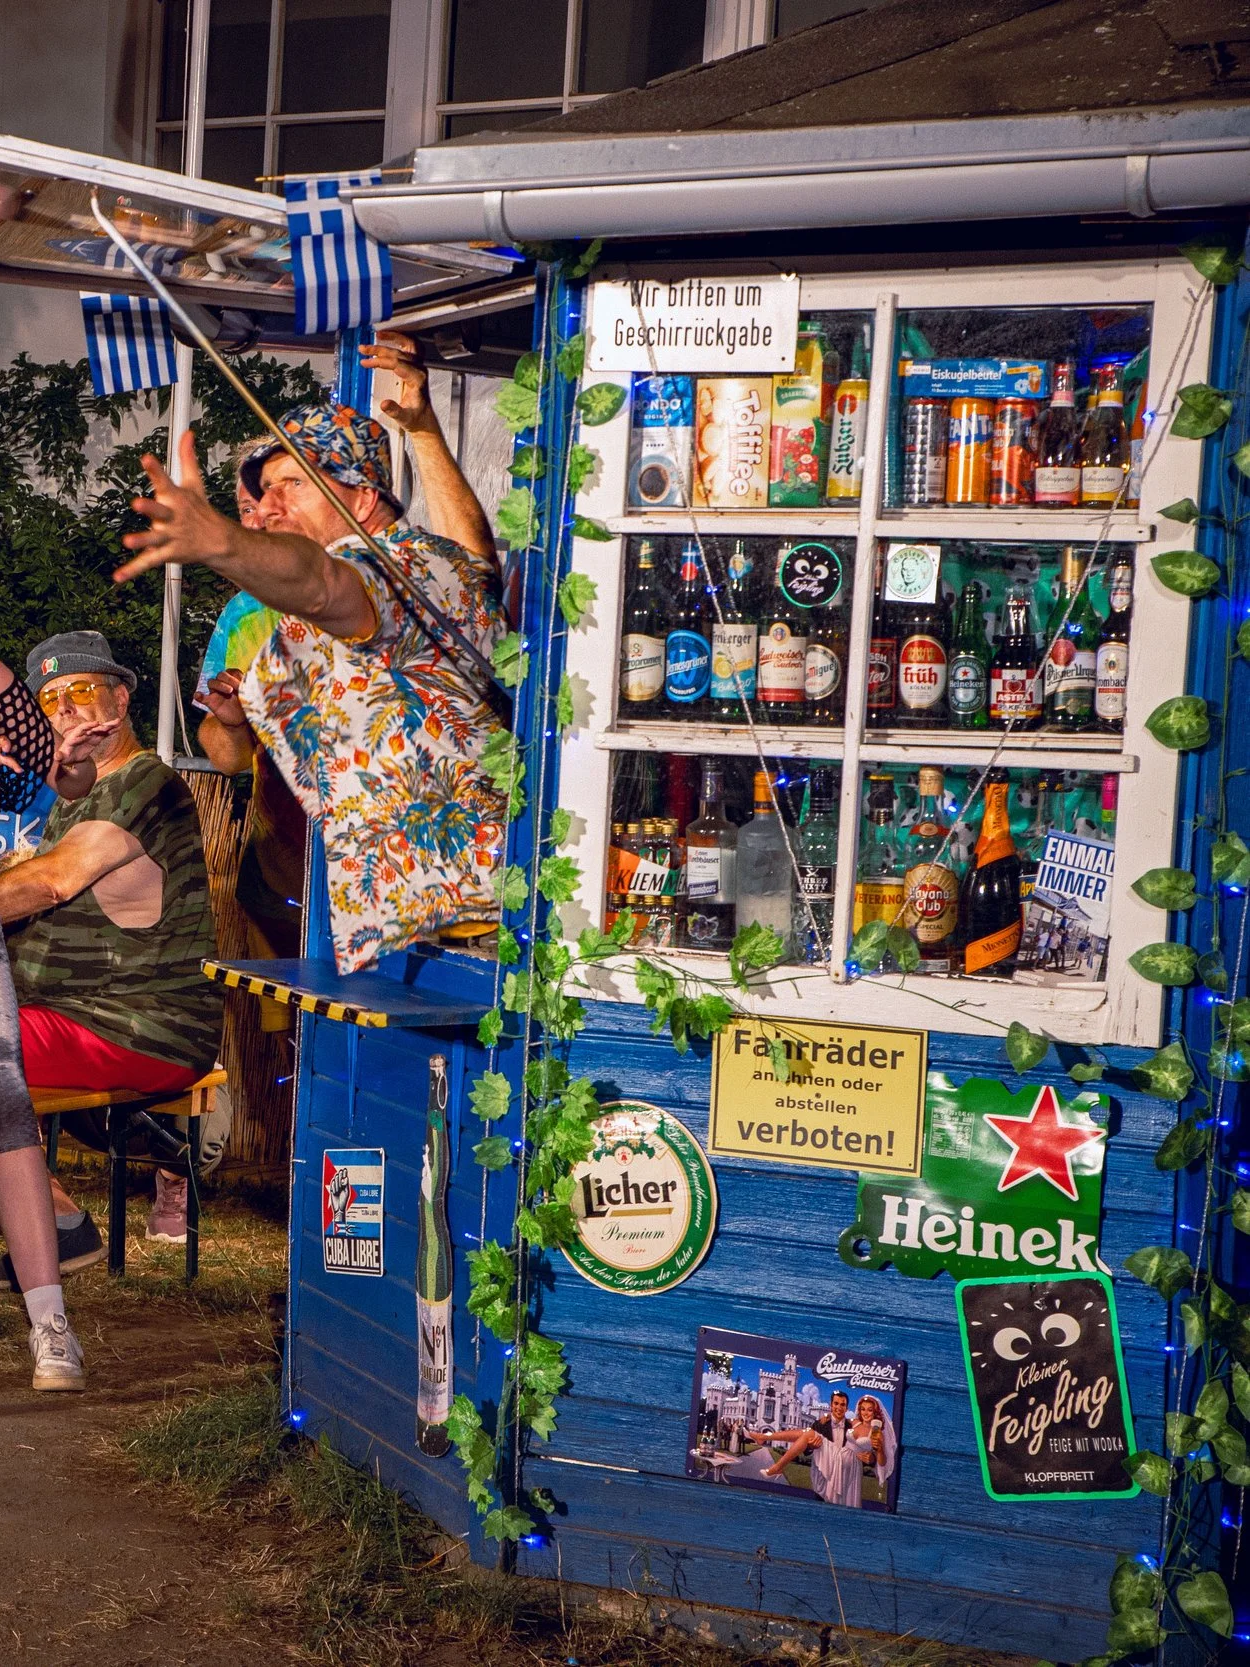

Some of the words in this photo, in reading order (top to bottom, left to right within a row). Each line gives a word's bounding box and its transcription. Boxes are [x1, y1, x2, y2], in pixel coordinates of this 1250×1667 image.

[668, 282, 726, 307] bitten
[735, 286, 762, 306] um
[614, 318, 772, 355] Geschirrückgabe
[931, 367, 1002, 382] Eiskugelbeutel
[729, 389, 763, 496] Toffifee
[904, 667, 938, 686] früh
[998, 693, 1031, 702] ASTRA
[1044, 836, 1114, 876] EINMAL
[1038, 864, 1107, 902] IMMER
[915, 899, 941, 912] Club
[753, 1070, 835, 1088] anehnen
[842, 1077, 883, 1092] oder
[775, 1096, 857, 1115] abstellen
[737, 1118, 895, 1157] verboten!
[579, 1171, 677, 1219] Licher
[601, 1221, 665, 1242] Premium
[877, 1194, 1112, 1276] Heinek
[325, 1237, 349, 1267] CUBA
[351, 1239, 379, 1268] LIBRE
[573, 1250, 594, 1270] Aus
[593, 1264, 613, 1282] dem
[614, 1270, 655, 1287] Herzen
[656, 1267, 671, 1283] der
[672, 1246, 694, 1275] Natur
[816, 1352, 899, 1383] Budweiser
[850, 1374, 897, 1392] Budvar
[1016, 1358, 1069, 1391] Kleiner
[988, 1369, 1114, 1456] Feigling
[1049, 1437, 1073, 1453] FEIGE
[1076, 1437, 1090, 1452] MIT
[1092, 1436, 1124, 1452] WODKA
[1024, 1471, 1095, 1482] KLOPFBRETT
